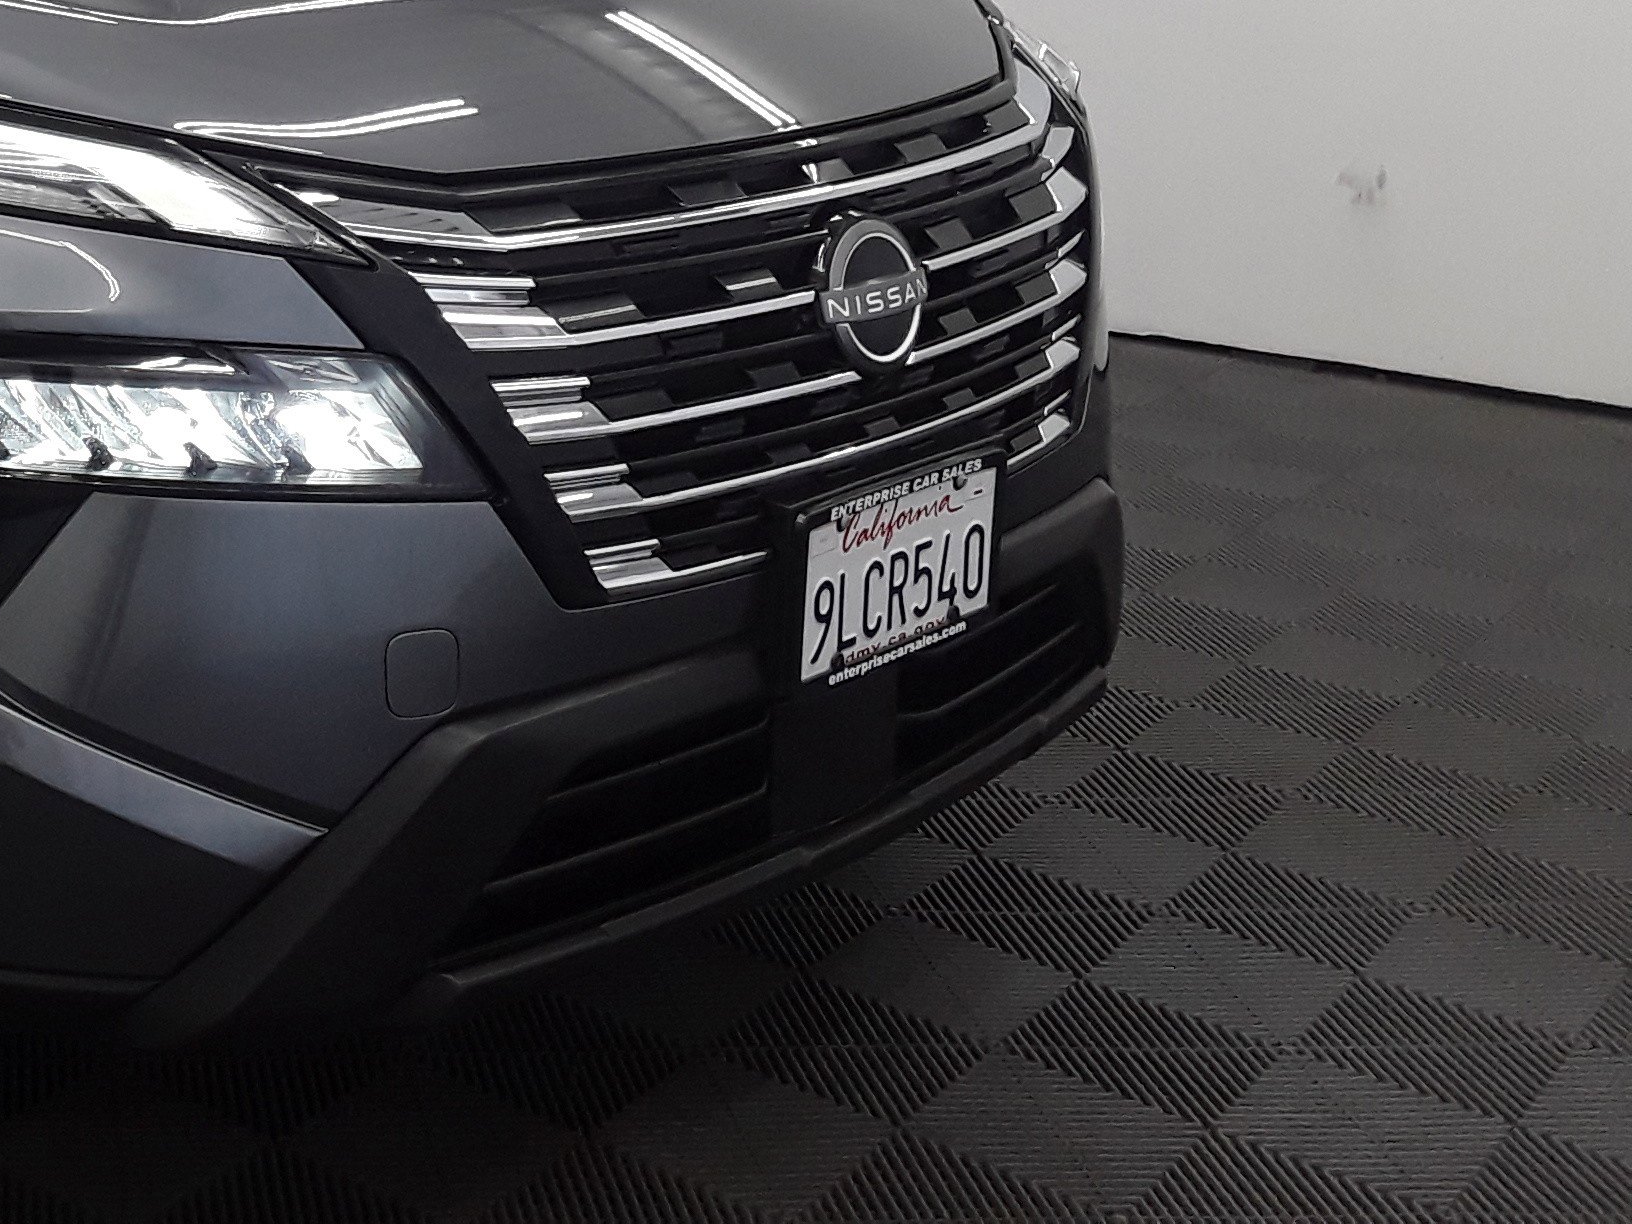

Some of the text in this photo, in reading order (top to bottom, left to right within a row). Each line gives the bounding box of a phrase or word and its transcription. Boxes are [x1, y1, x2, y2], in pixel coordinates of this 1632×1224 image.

[827, 278, 927, 318] NISSAN
[830, 458, 983, 520] ENTERPRISE CAR SALES
[841, 494, 964, 553] California
[810, 523, 986, 665] 9LCR540
[828, 621, 967, 686] enterprisecarsales.com
